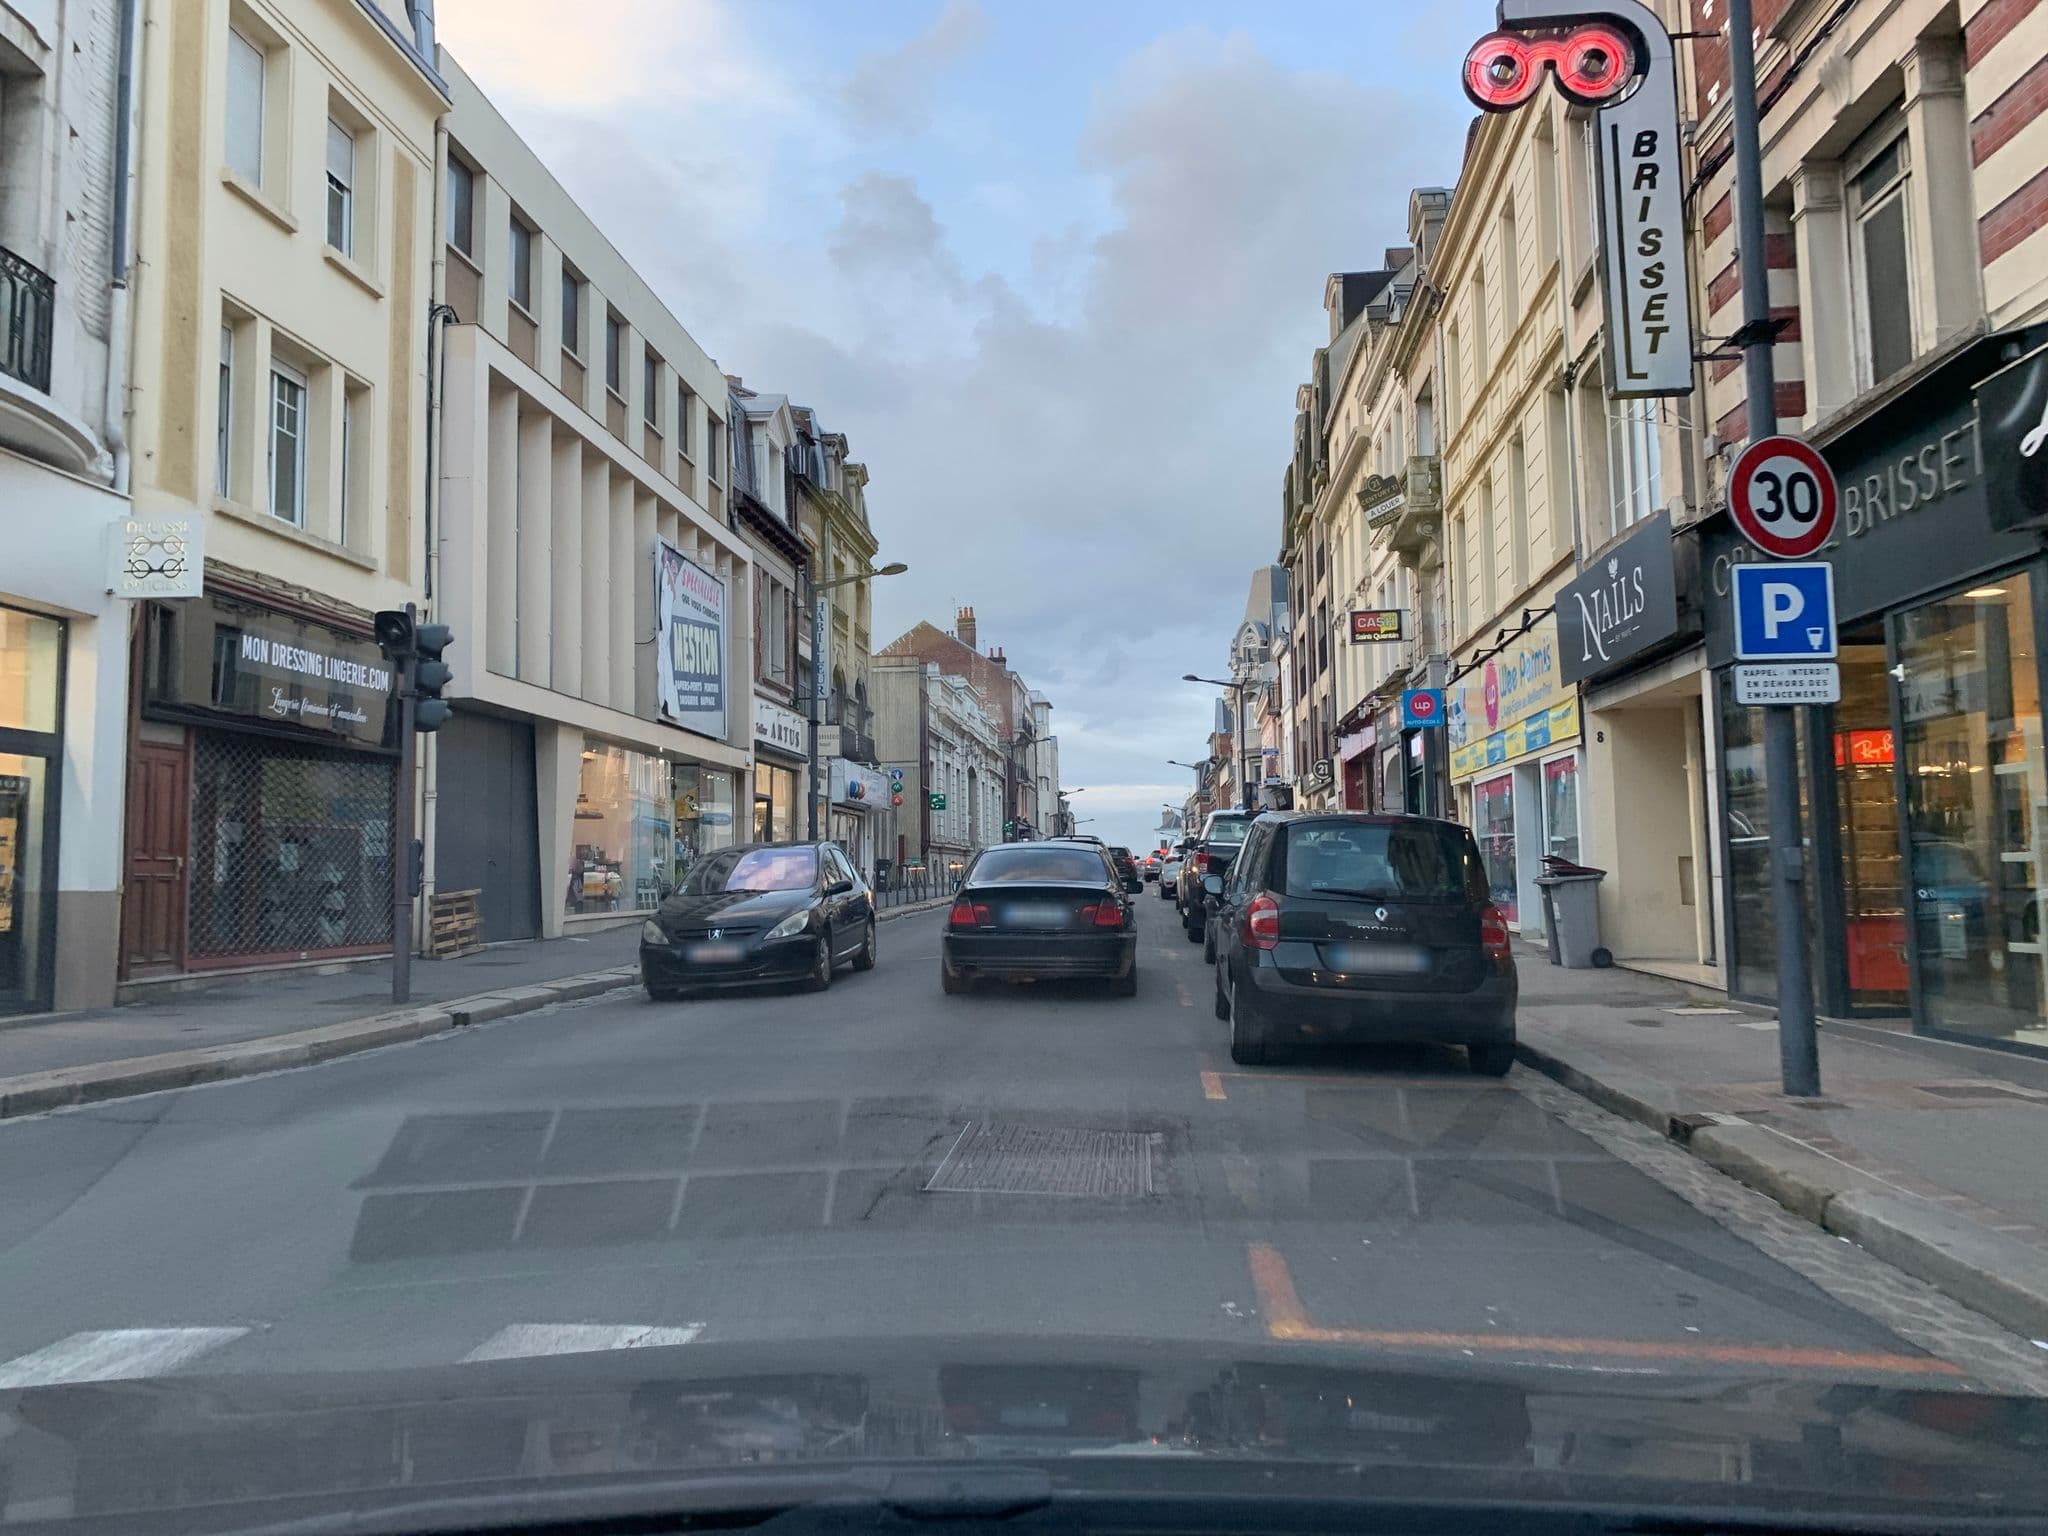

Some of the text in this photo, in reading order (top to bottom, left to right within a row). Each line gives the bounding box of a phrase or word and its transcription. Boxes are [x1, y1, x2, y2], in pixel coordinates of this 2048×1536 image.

[1632, 130, 1669, 353] BRISSET
[1845, 416, 1983, 537] BRISSET
[1377, 498, 1400, 514] LOUER
[1755, 471, 1819, 523] 30
[1357, 614, 1395, 628] CASH
[1573, 567, 1645, 661] NAILS
[1762, 583, 1805, 639] P
[673, 622, 718, 676] MESTION
[242, 634, 390, 692] MON DRESSING LINGERIE.COM
[1743, 667, 1829, 677] RAPPEL INTERDIT
[1746, 679, 1829, 688] EN DEHORS DES
[1747, 690, 1829, 699] EMPLACEMENTS
[770, 722, 800, 748] ARTUS
[1597, 731, 1604, 743] 8
[1317, 764, 1328, 775] 21
